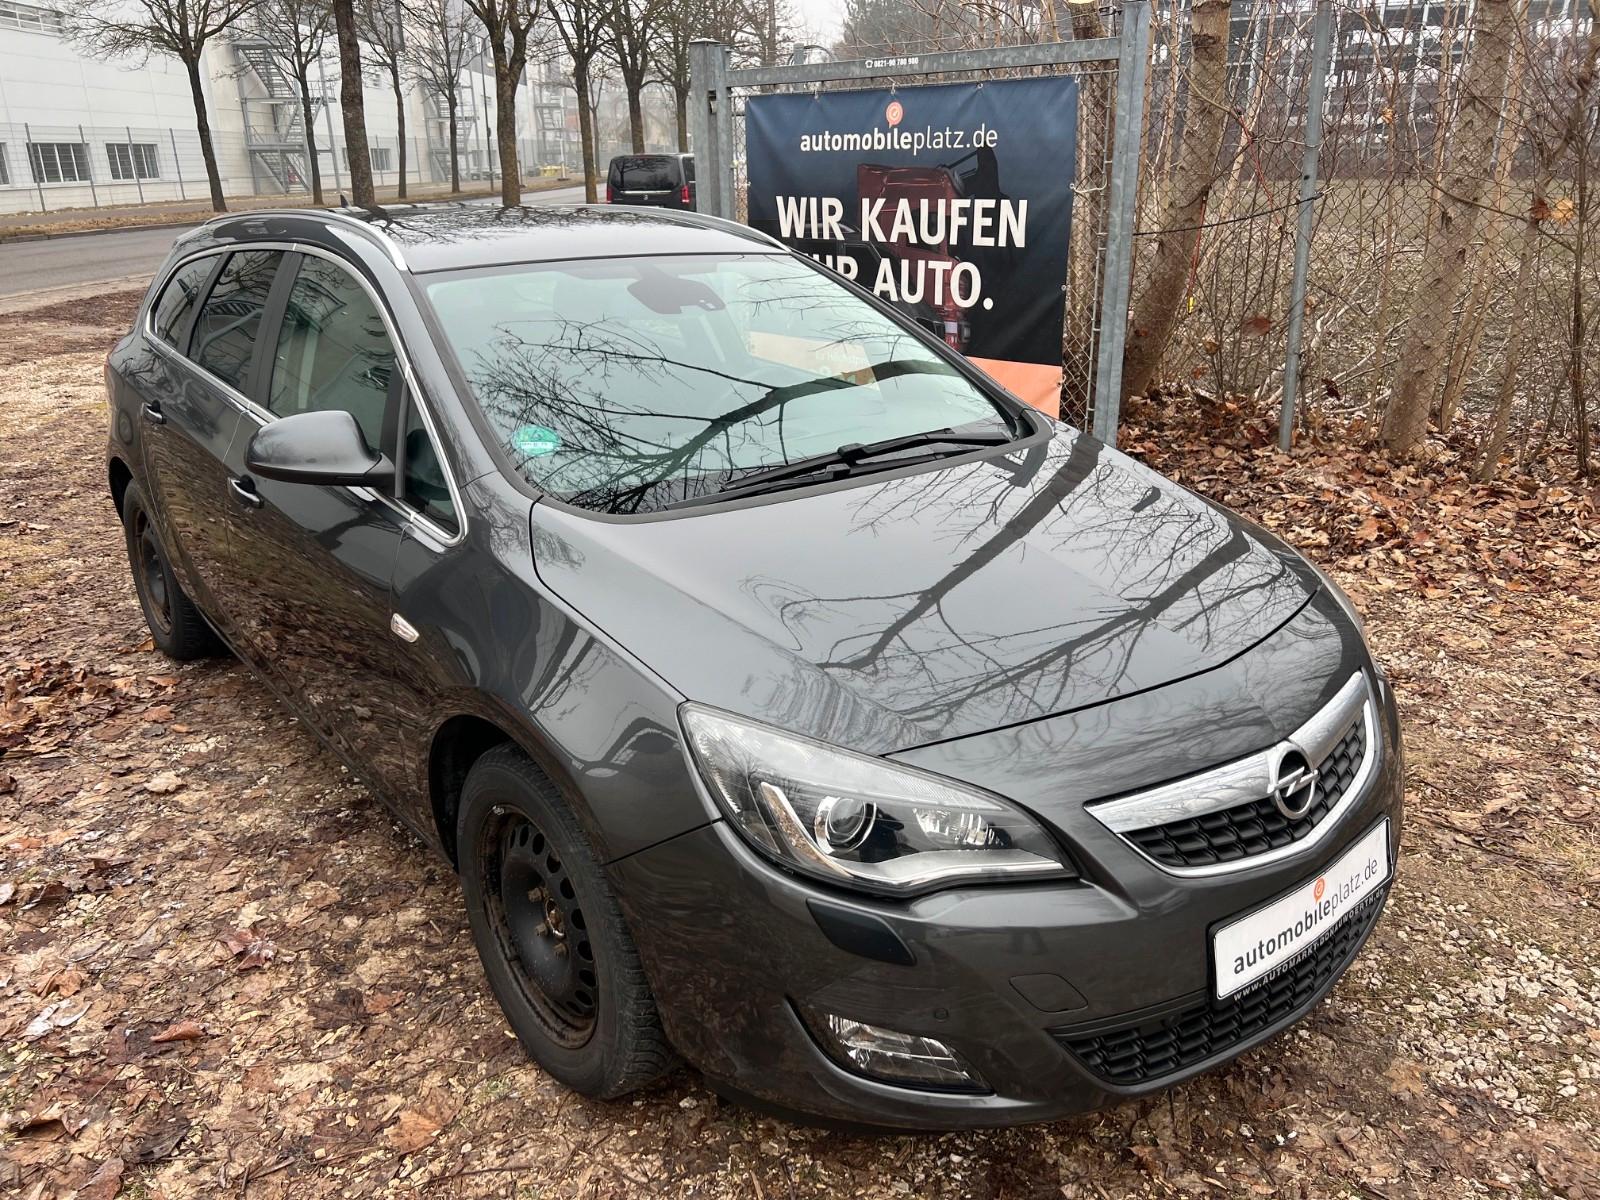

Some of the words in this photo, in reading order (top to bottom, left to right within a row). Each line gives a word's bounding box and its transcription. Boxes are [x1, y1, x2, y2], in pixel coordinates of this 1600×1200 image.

[800, 123, 998, 156] automobileplatz.de
[776, 195, 845, 241] WIR
[861, 197, 1028, 249] KAUFEN
[873, 257, 994, 311] AUTO.
[1233, 857, 1378, 975] automobileplatz.de
